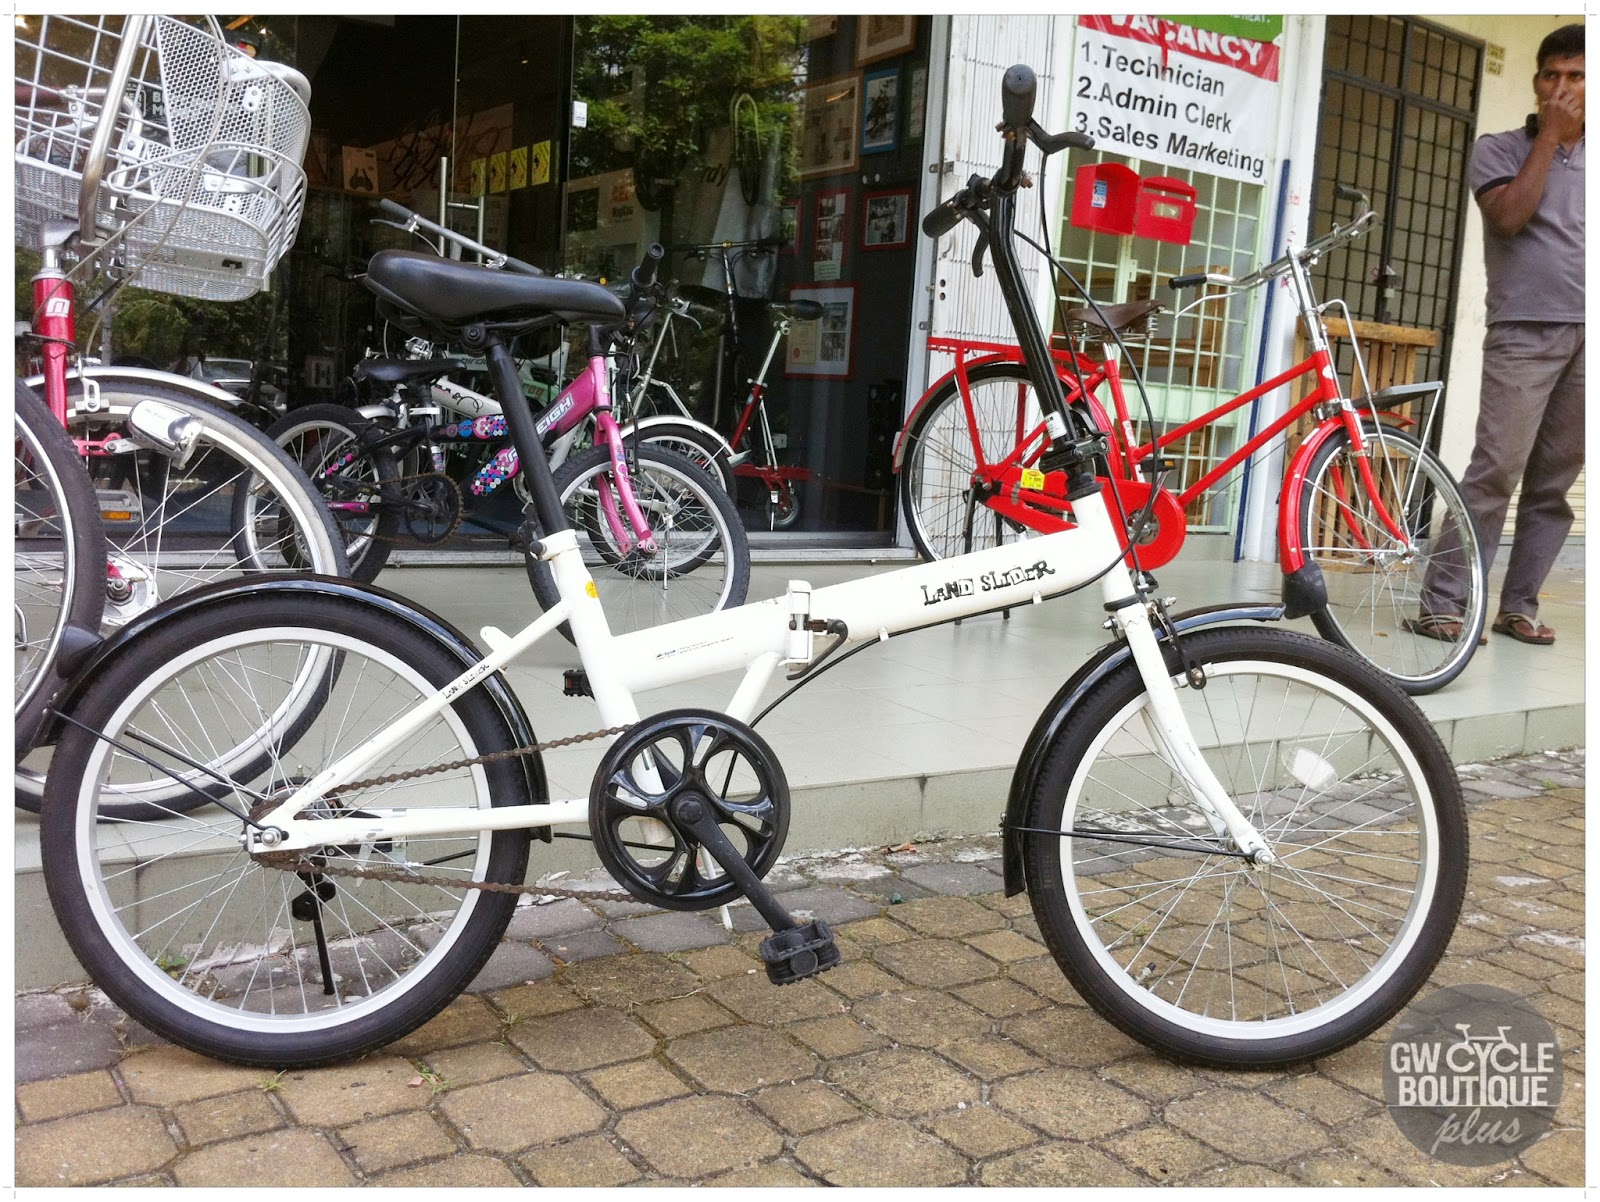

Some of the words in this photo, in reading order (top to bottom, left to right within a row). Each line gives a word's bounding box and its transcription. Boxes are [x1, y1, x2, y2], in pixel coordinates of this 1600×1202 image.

[1081, 40, 1225, 97] 1.Technician
[1076, 75, 1178, 119] 2.Admin
[1184, 102, 1232, 135] Clerk
[1075, 111, 1159, 149] 3.Sales
[1165, 132, 1265, 179] Marketing
[536, 394, 573, 435] EIGH
[920, 578, 975, 606] LAND
[980, 560, 1056, 592] SLIDER
